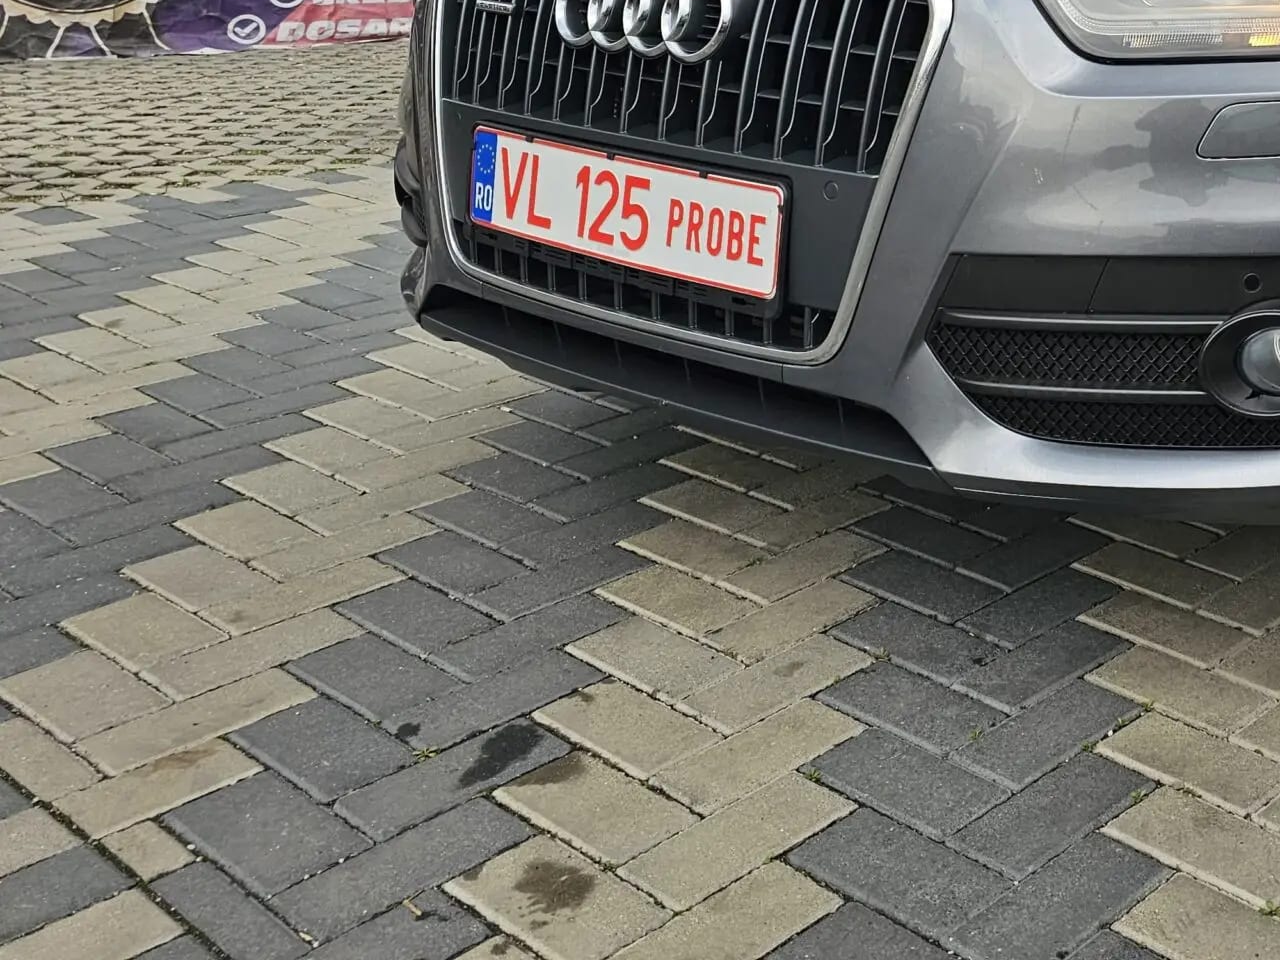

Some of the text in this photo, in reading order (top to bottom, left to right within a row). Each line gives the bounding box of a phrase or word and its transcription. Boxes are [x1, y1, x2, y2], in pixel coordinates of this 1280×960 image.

[474, 146, 767, 267] RO VL 125 PROBE
